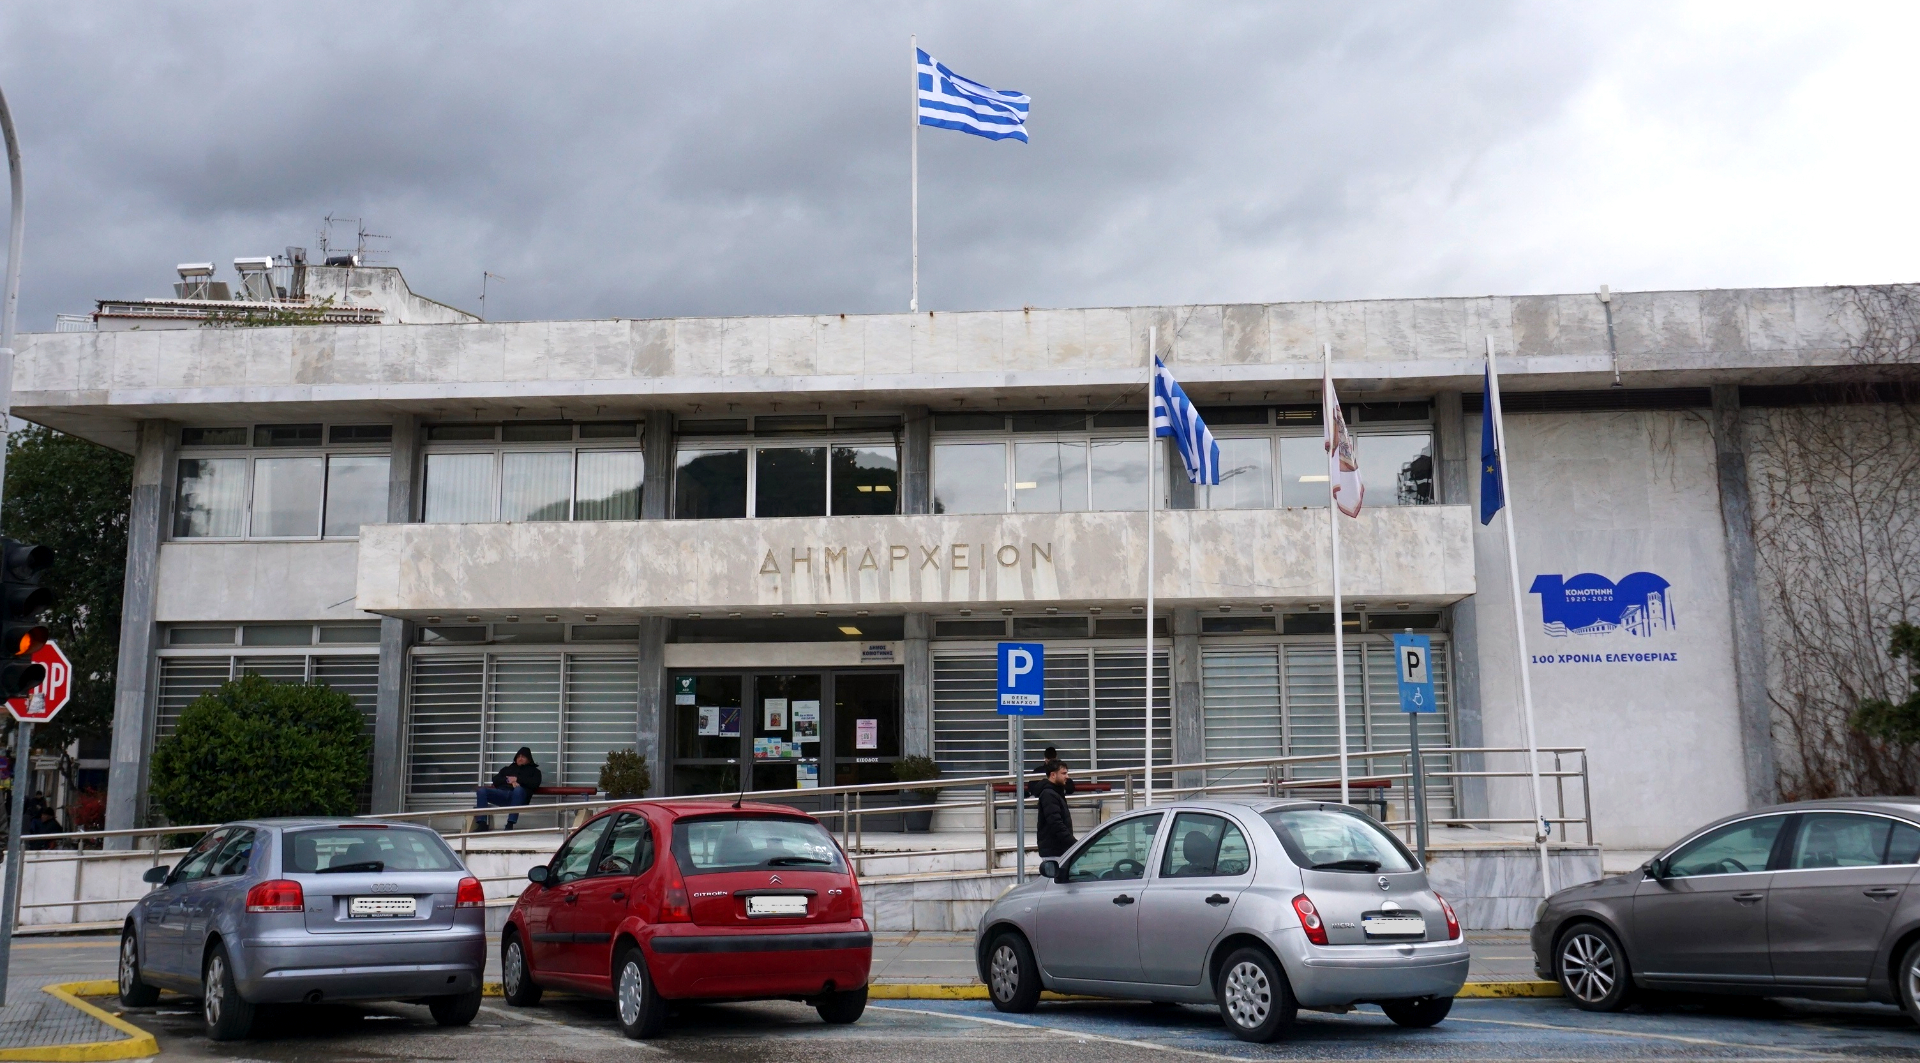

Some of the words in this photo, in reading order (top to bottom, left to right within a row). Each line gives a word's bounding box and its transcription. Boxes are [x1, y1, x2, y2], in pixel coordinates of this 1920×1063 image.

[759, 543, 1052, 574] ΔΗΜΑΡΧΕΙΟΝ
[1565, 588, 1613, 596] ΚΟΜΟΤΗΝΗ
[1008, 649, 1033, 687] P
[1407, 651, 1420, 677] P
[1532, 654, 1554, 664] 100
[1559, 653, 1602, 663] ΧΡΟΝΙΑ
[1606, 652, 1678, 662] ΕΛΕΥΘΕΡΙΑΣ
